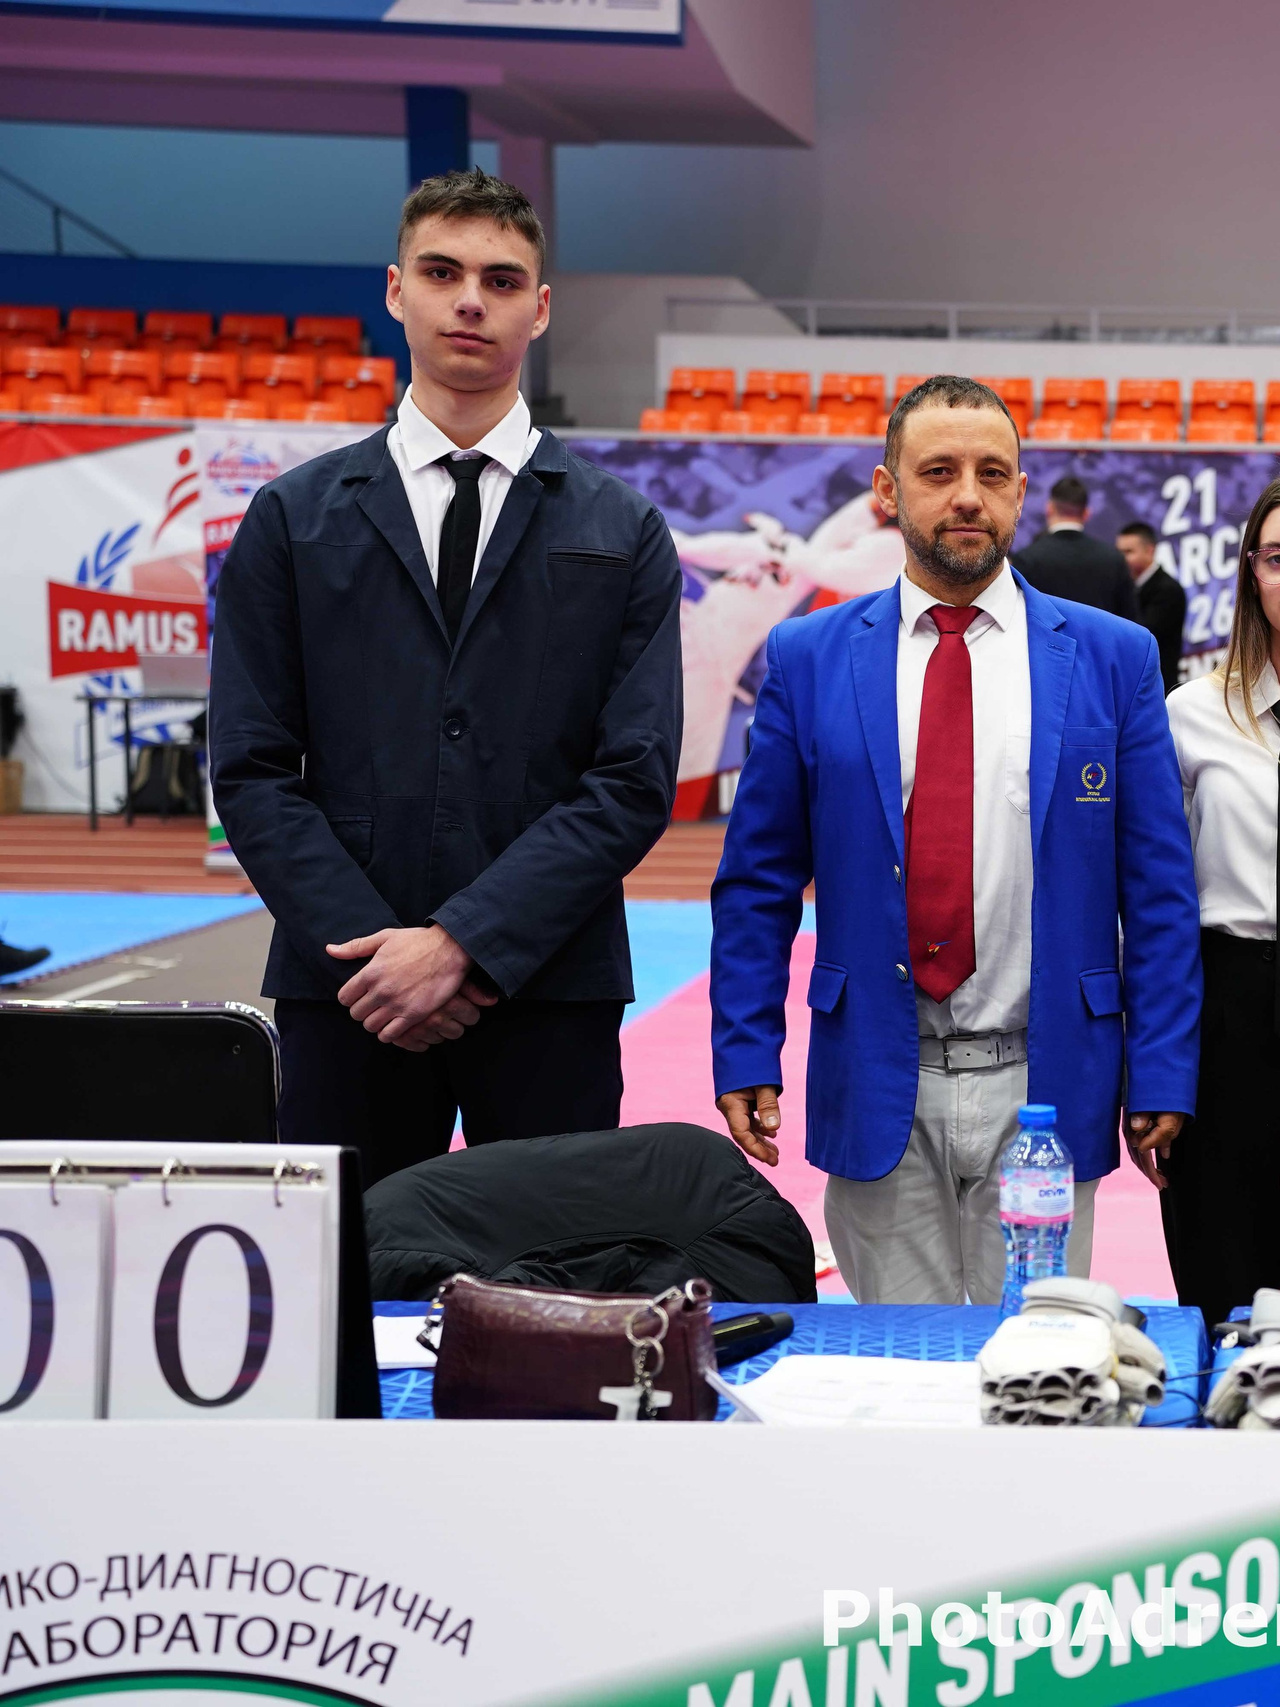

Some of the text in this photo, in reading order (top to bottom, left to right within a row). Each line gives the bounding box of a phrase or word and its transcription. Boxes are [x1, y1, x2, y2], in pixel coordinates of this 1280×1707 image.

[1161, 467, 1217, 536] 21
[1154, 522, 1246, 589] ARC
[58, 608, 199, 655] RAMUS
[1186, 587, 1235, 645] 26
[153, 1223, 275, 1408] 0
[2, 1612, 398, 1687] АБОРАТОРИЯ
